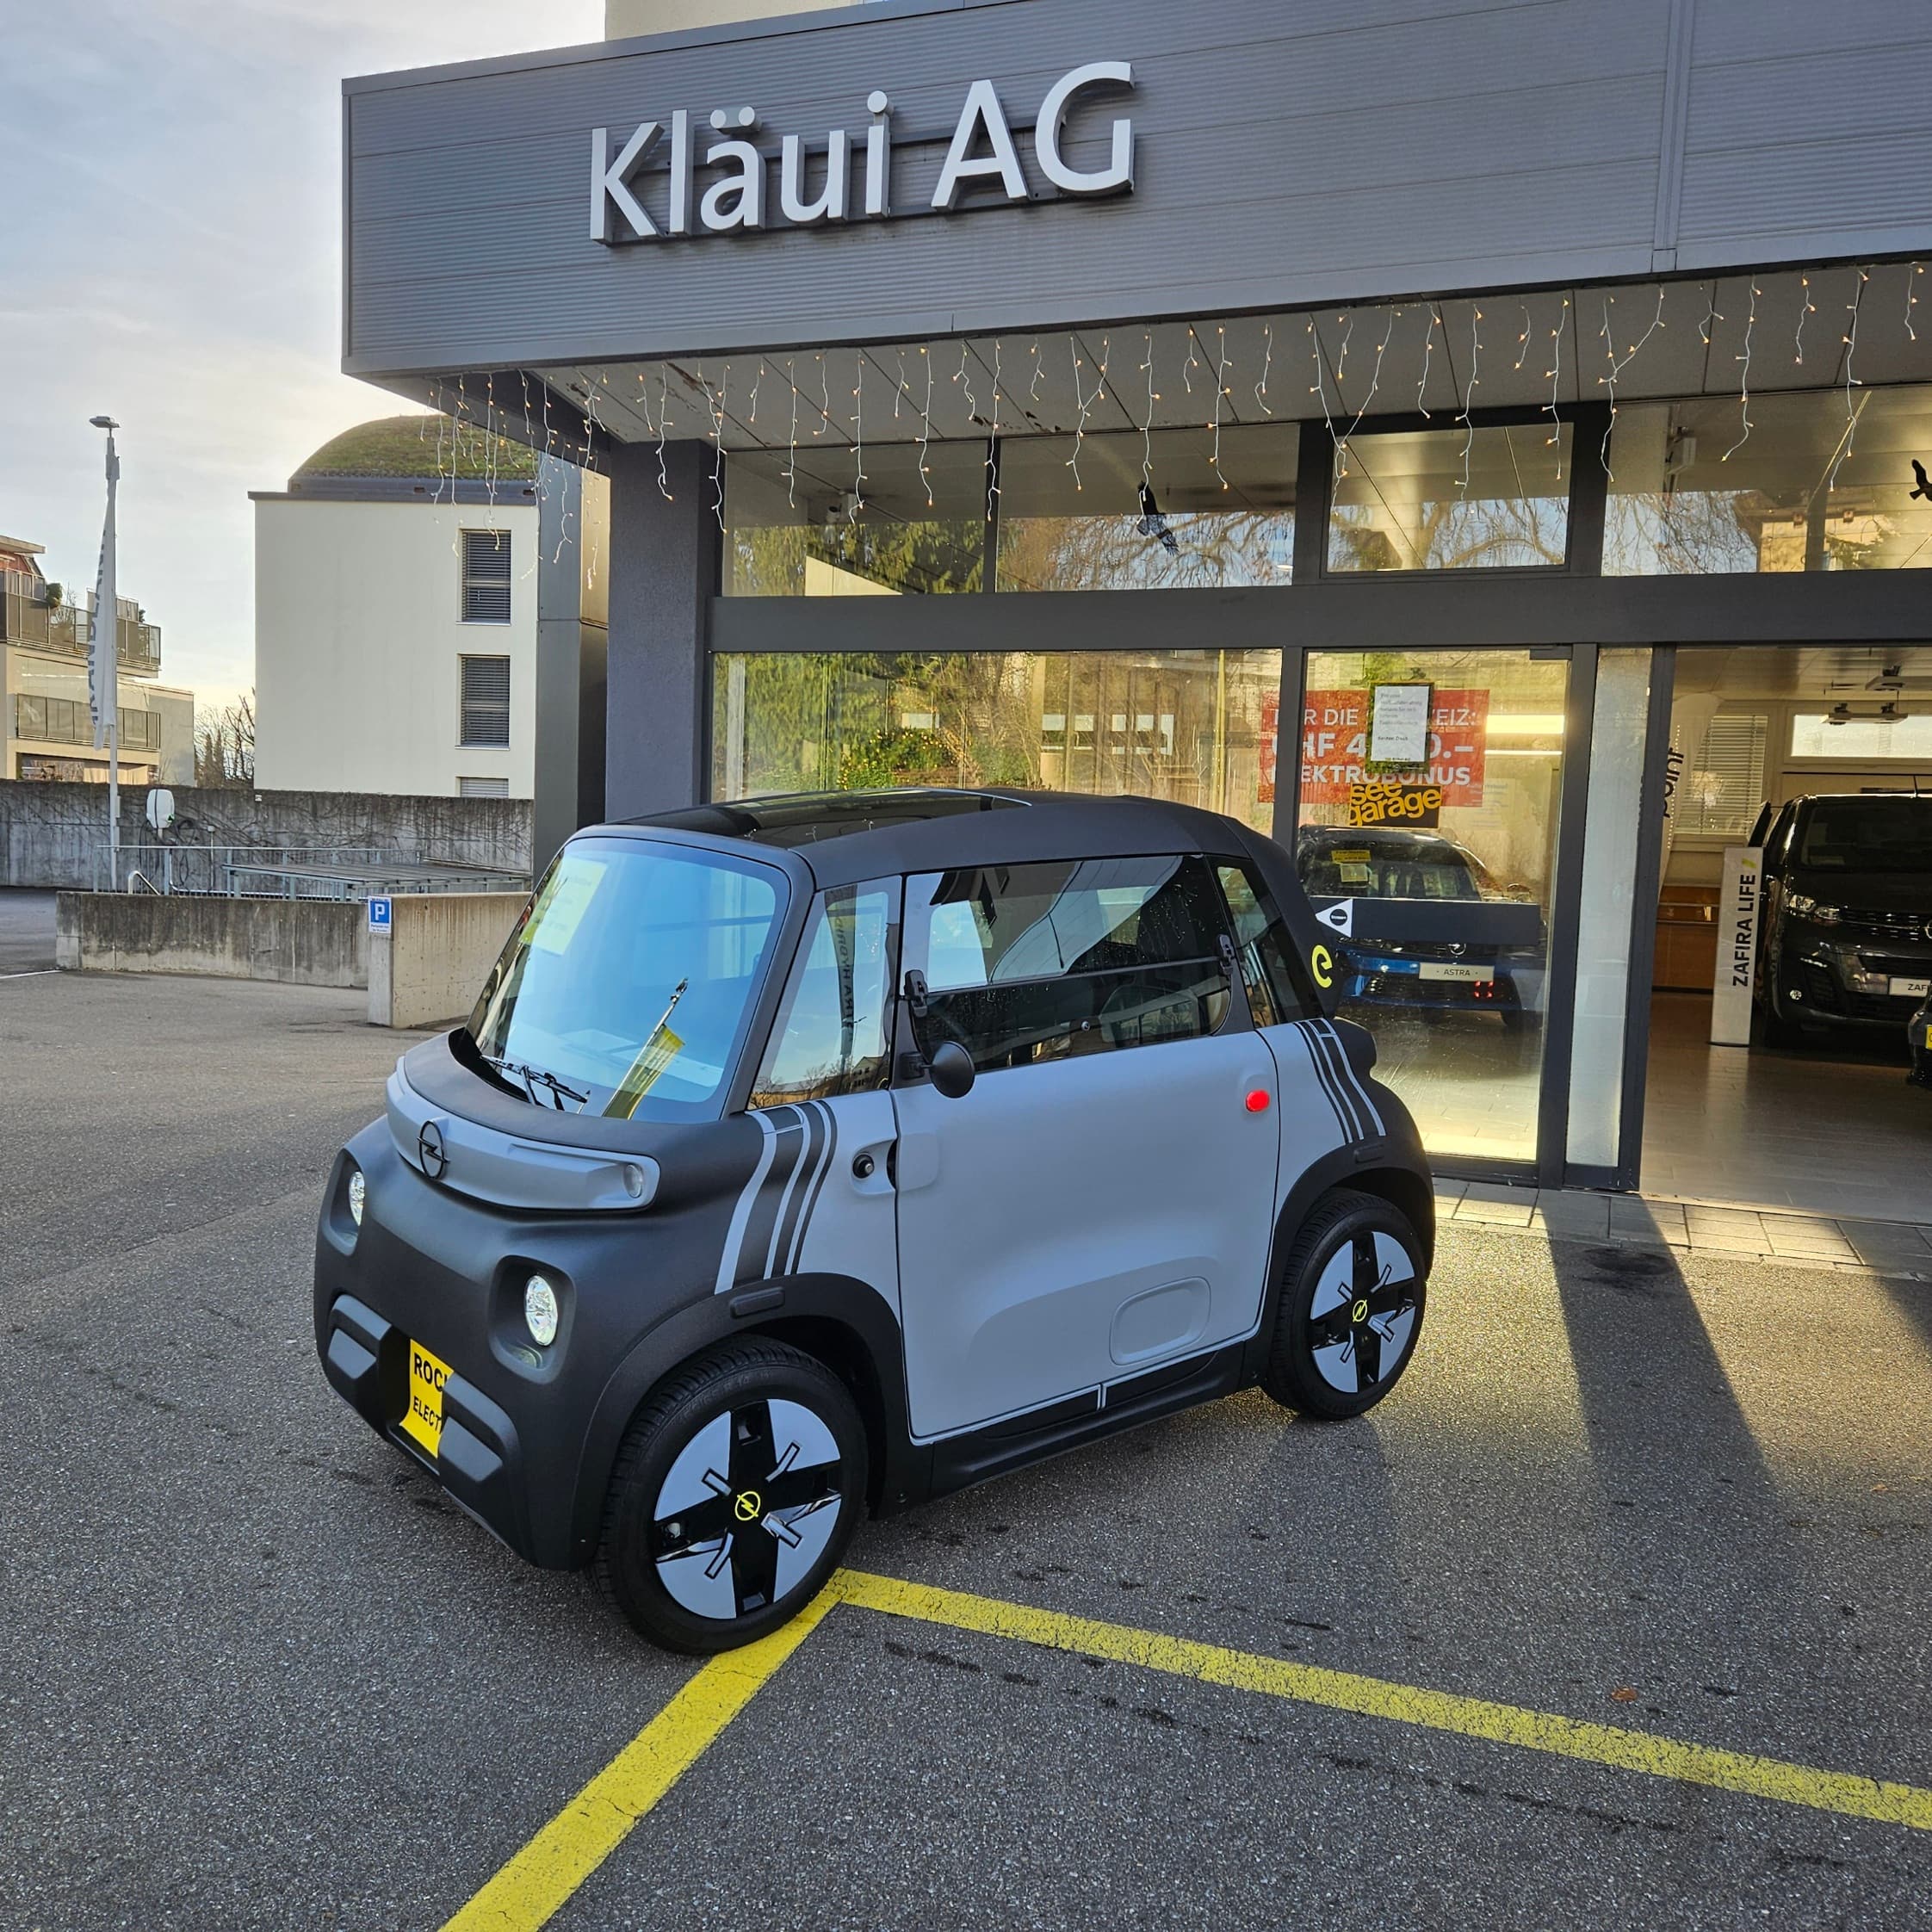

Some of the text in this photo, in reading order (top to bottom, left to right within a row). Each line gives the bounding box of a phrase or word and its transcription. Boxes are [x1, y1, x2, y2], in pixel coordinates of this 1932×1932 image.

[590, 61, 1133, 242] Kläui AG
[1324, 709, 1359, 726] DIE
[1349, 789, 1441, 827] garage
[1351, 783, 1403, 805] see
[375, 903, 386, 921] P
[1732, 874, 1756, 987] ZAFIRA LIFE
